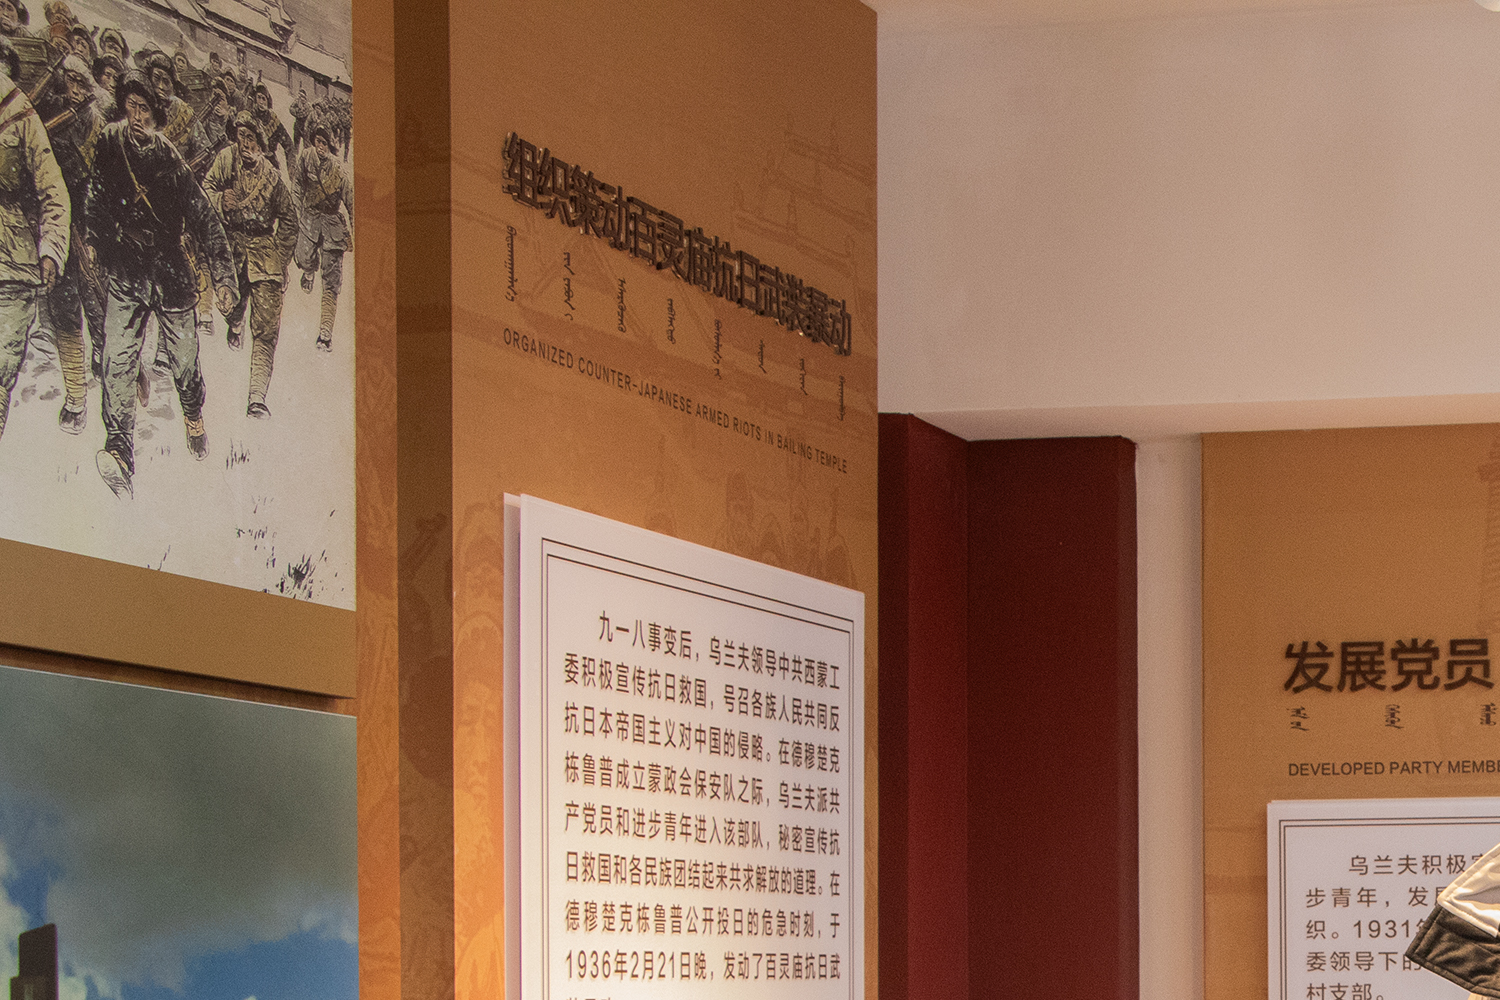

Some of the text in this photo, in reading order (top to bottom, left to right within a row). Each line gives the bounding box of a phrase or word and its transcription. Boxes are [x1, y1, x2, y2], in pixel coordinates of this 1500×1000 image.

[501, 131, 851, 356] 组织策动百灵庙抗日武装暴动
[503, 328, 847, 474] ORGANIZED COUNTER-JAPANESE ARMED RIOTS IN BAILING TEMPLE
[1283, 638, 1495, 694] 发展党员
[1288, 761, 1385, 777] DEVELOPED
[1390, 760, 1444, 775] PARTY
[1306, 951, 1422, 972] 委领导下的
